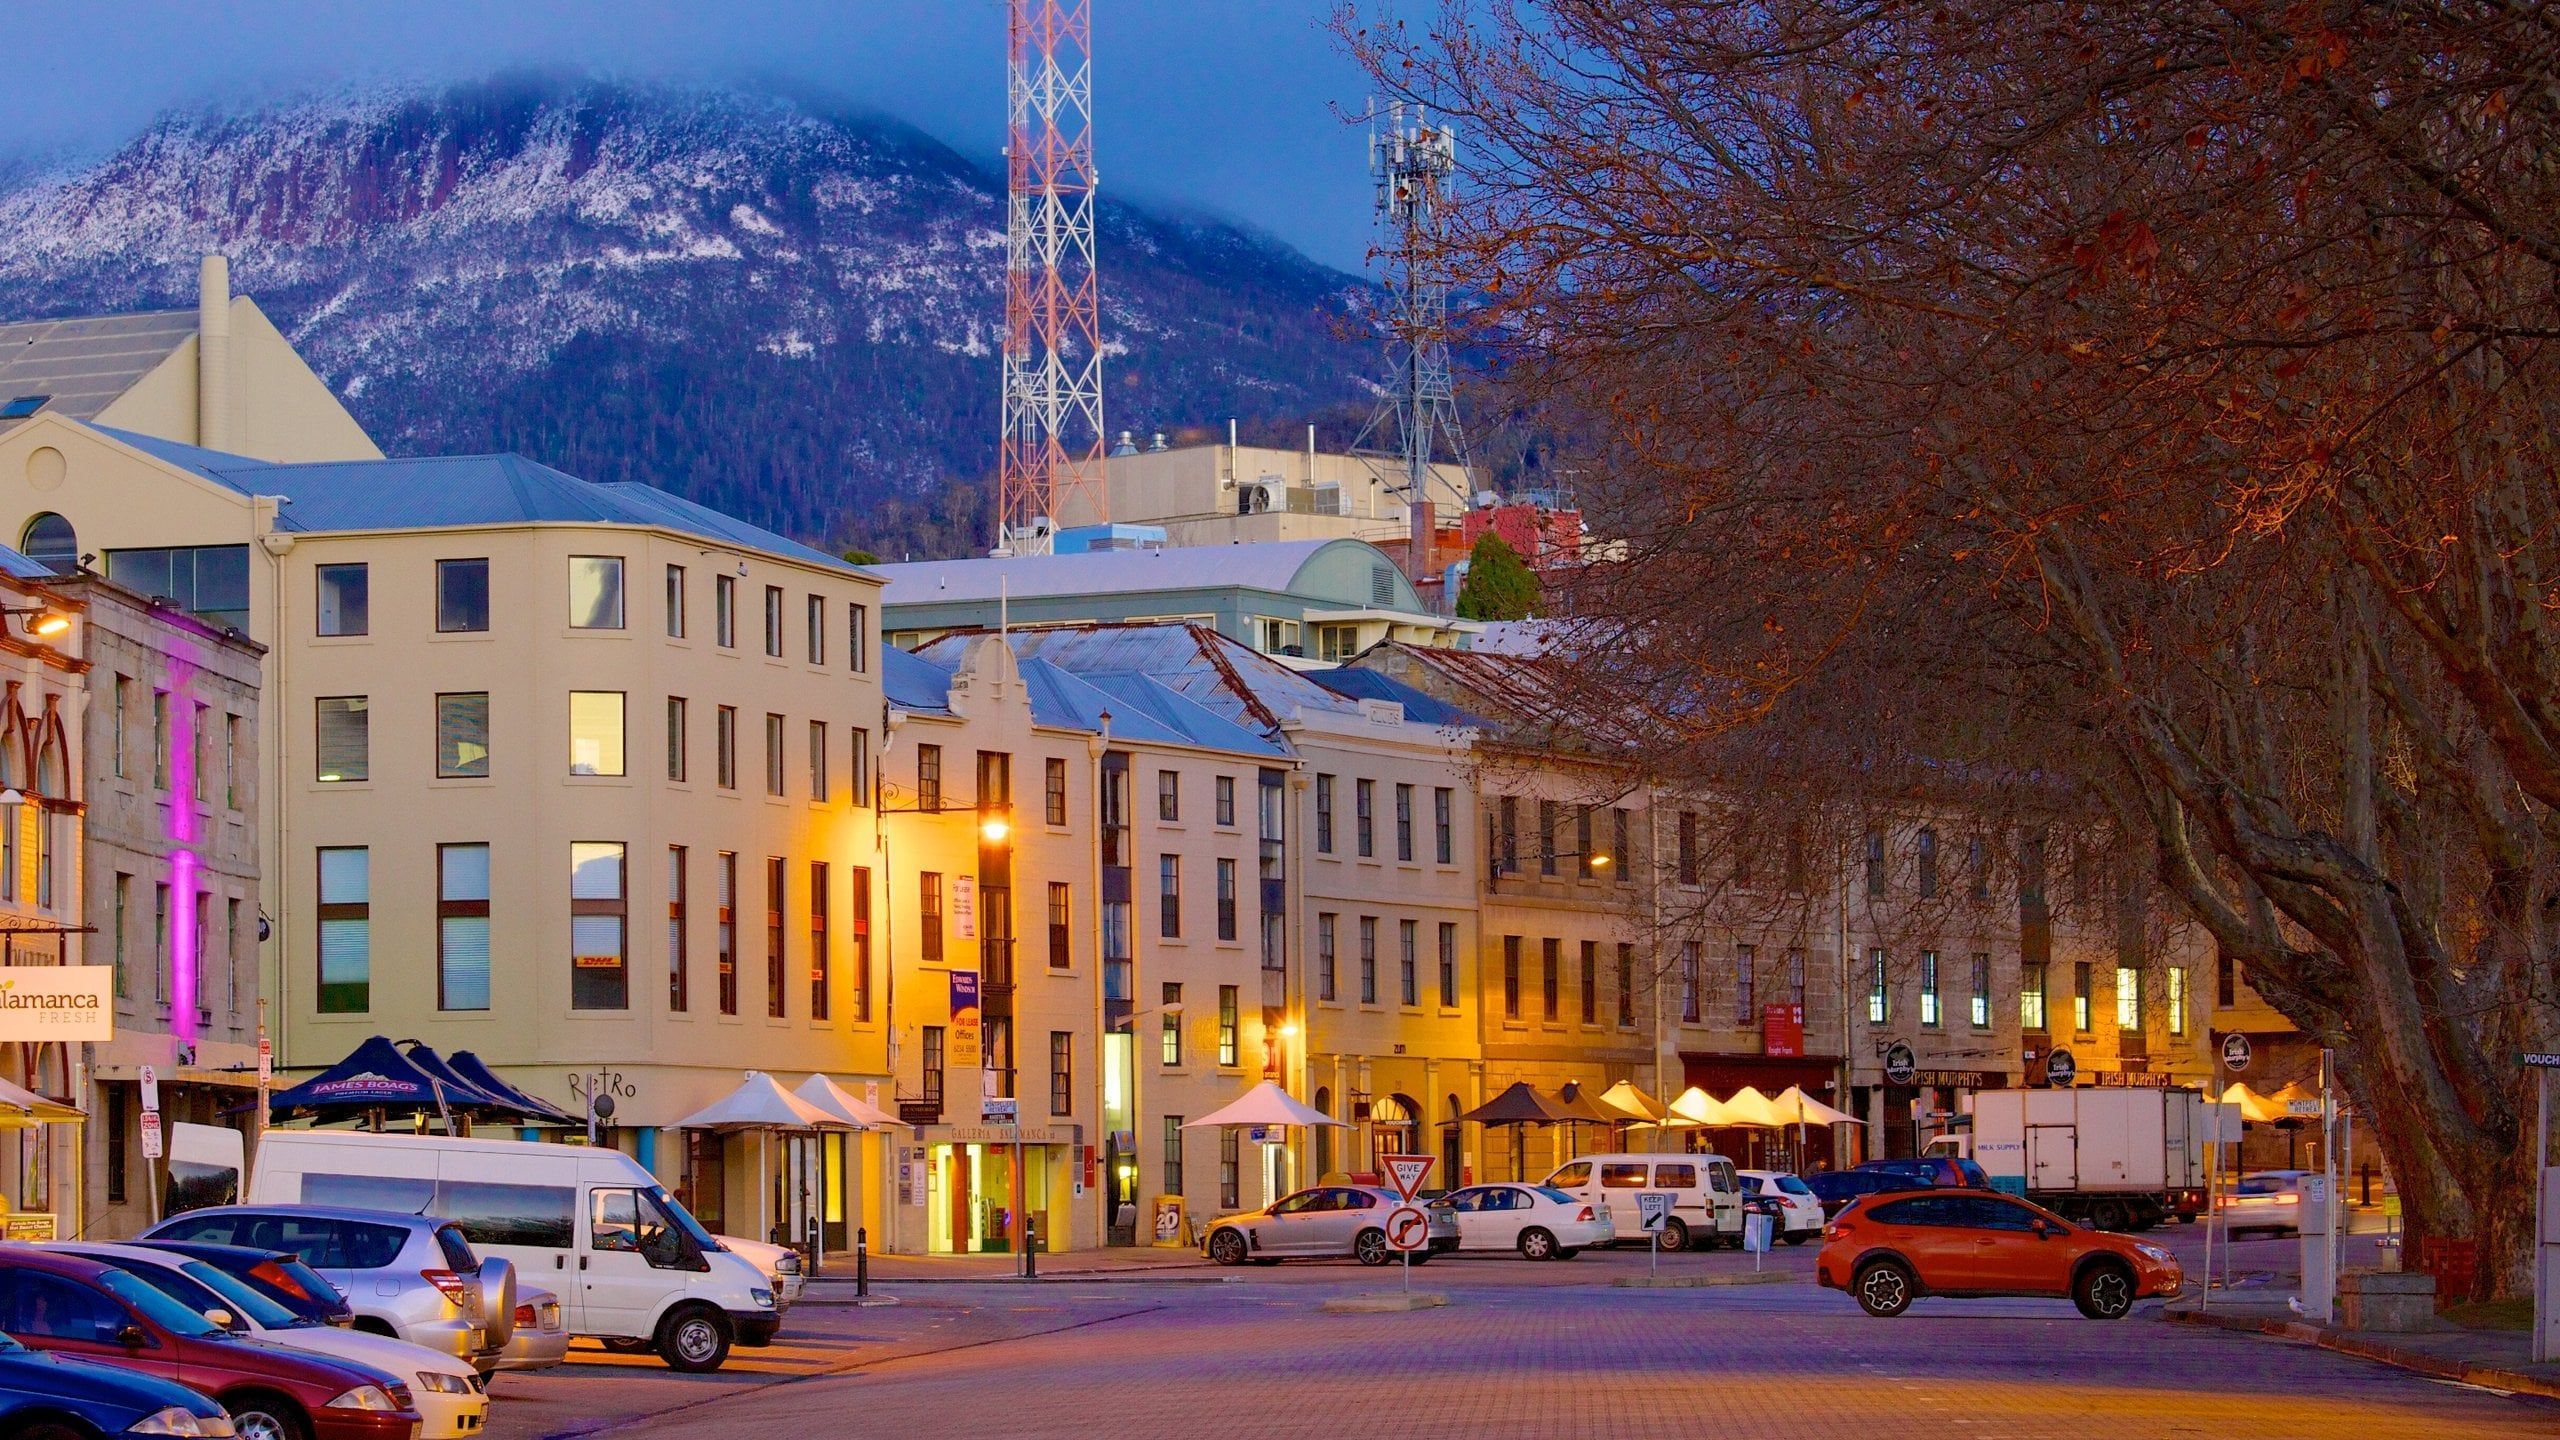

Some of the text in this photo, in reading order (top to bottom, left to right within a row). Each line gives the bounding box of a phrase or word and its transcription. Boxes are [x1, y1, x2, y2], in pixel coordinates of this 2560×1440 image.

[583, 958, 614, 966] DHL
[0, 990, 99, 1009] lamanca
[40, 1012, 96, 1023] FRESH
[956, 1018, 978, 1026] FOR LEASE
[955, 1030, 974, 1040] Offices
[2229, 1048, 2244, 1056] Irish
[2523, 1053, 2560, 1065] VOUCH
[2053, 1062, 2069, 1071] Irish
[1938, 1071, 1982, 1086] MURPHY'S
[2101, 1072, 2168, 1086] IRISH MURPHY'S
[312, 1081, 418, 1094] JAMES BOAG'S
[952, 1127, 990, 1139] GALLERIA
[1000, 1127, 1046, 1139] SALMANCA
[1396, 1163, 1420, 1172] GIVE
[1156, 1211, 1179, 1230] 20
